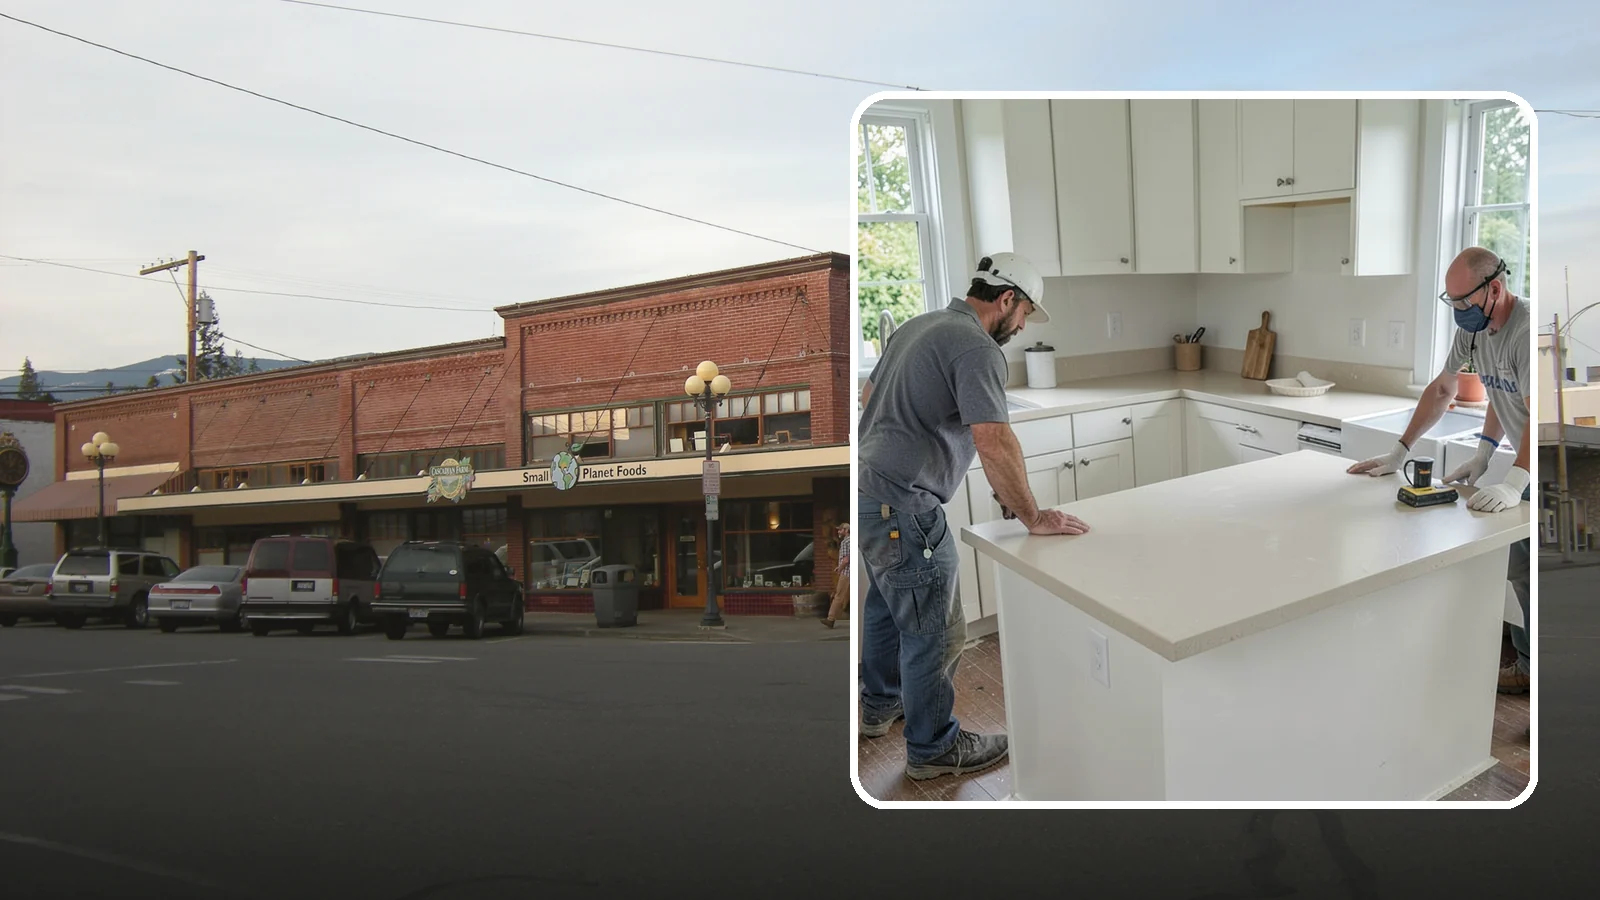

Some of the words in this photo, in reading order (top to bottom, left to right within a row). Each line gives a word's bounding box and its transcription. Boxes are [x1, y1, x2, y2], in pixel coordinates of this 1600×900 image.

[523, 471, 549, 483] Small
[583, 467, 614, 479] Planet
[617, 464, 647, 477] Foods
